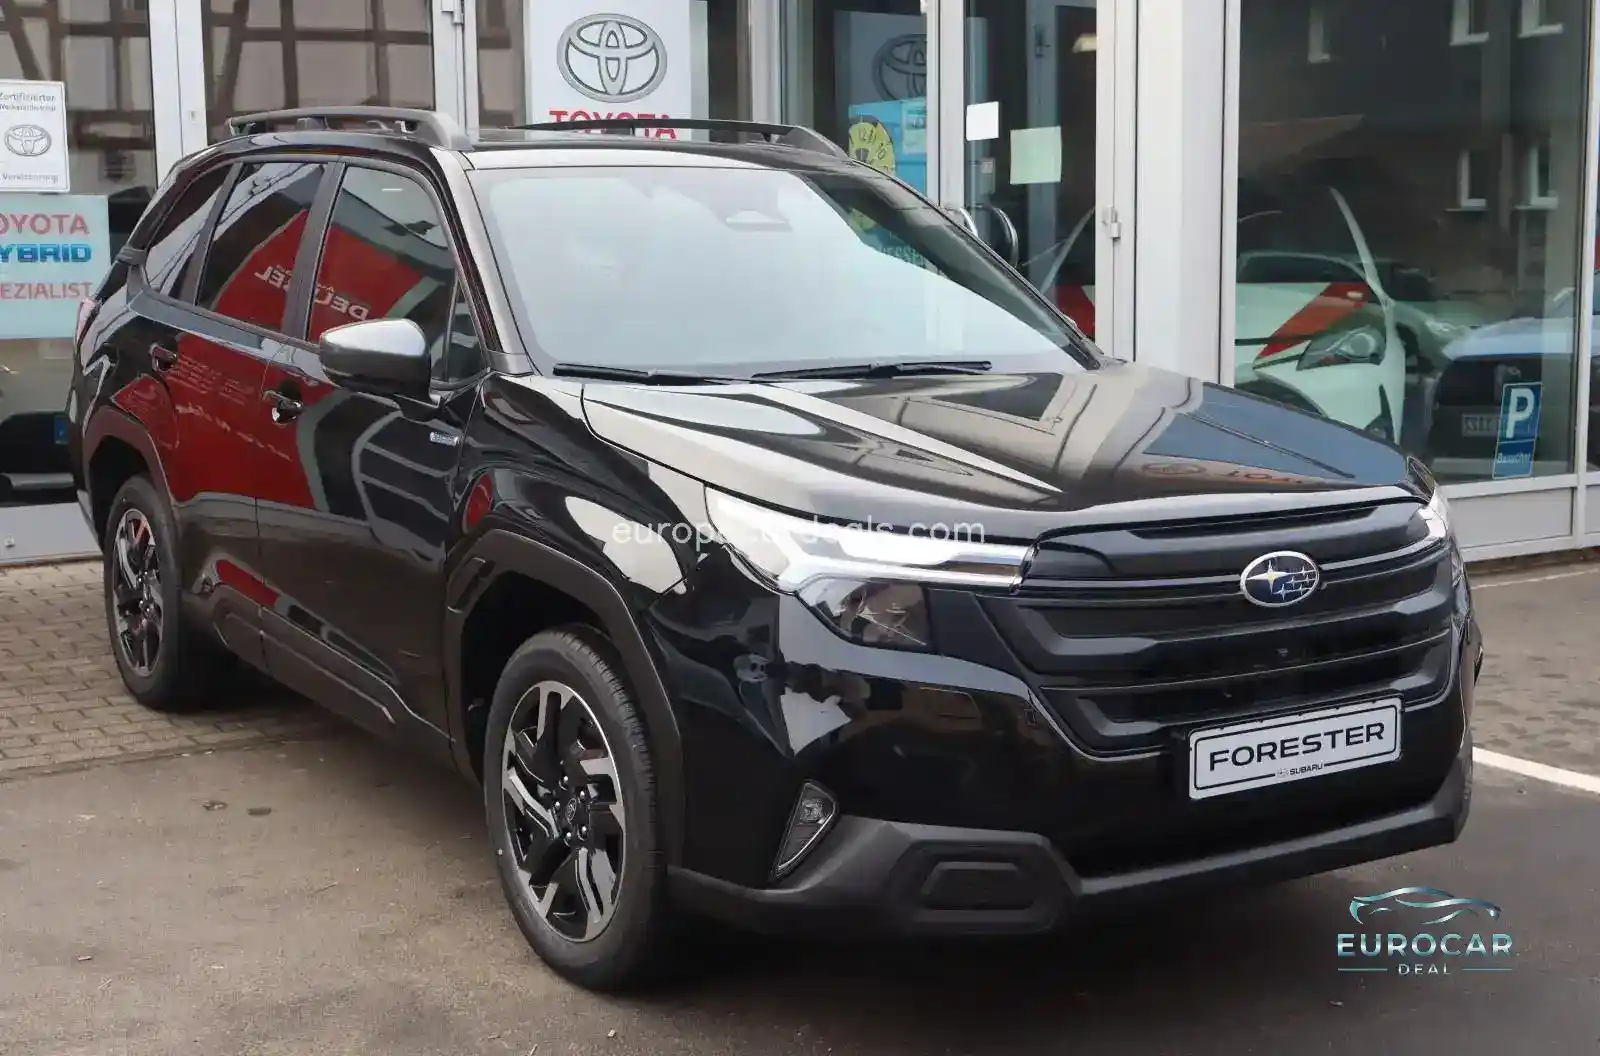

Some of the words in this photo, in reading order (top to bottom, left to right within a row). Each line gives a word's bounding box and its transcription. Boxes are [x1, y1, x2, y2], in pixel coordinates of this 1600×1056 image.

[1505, 388, 1535, 439] P
[1209, 722, 1385, 771] FORESTER
[1289, 763, 1324, 776] SUBARU
